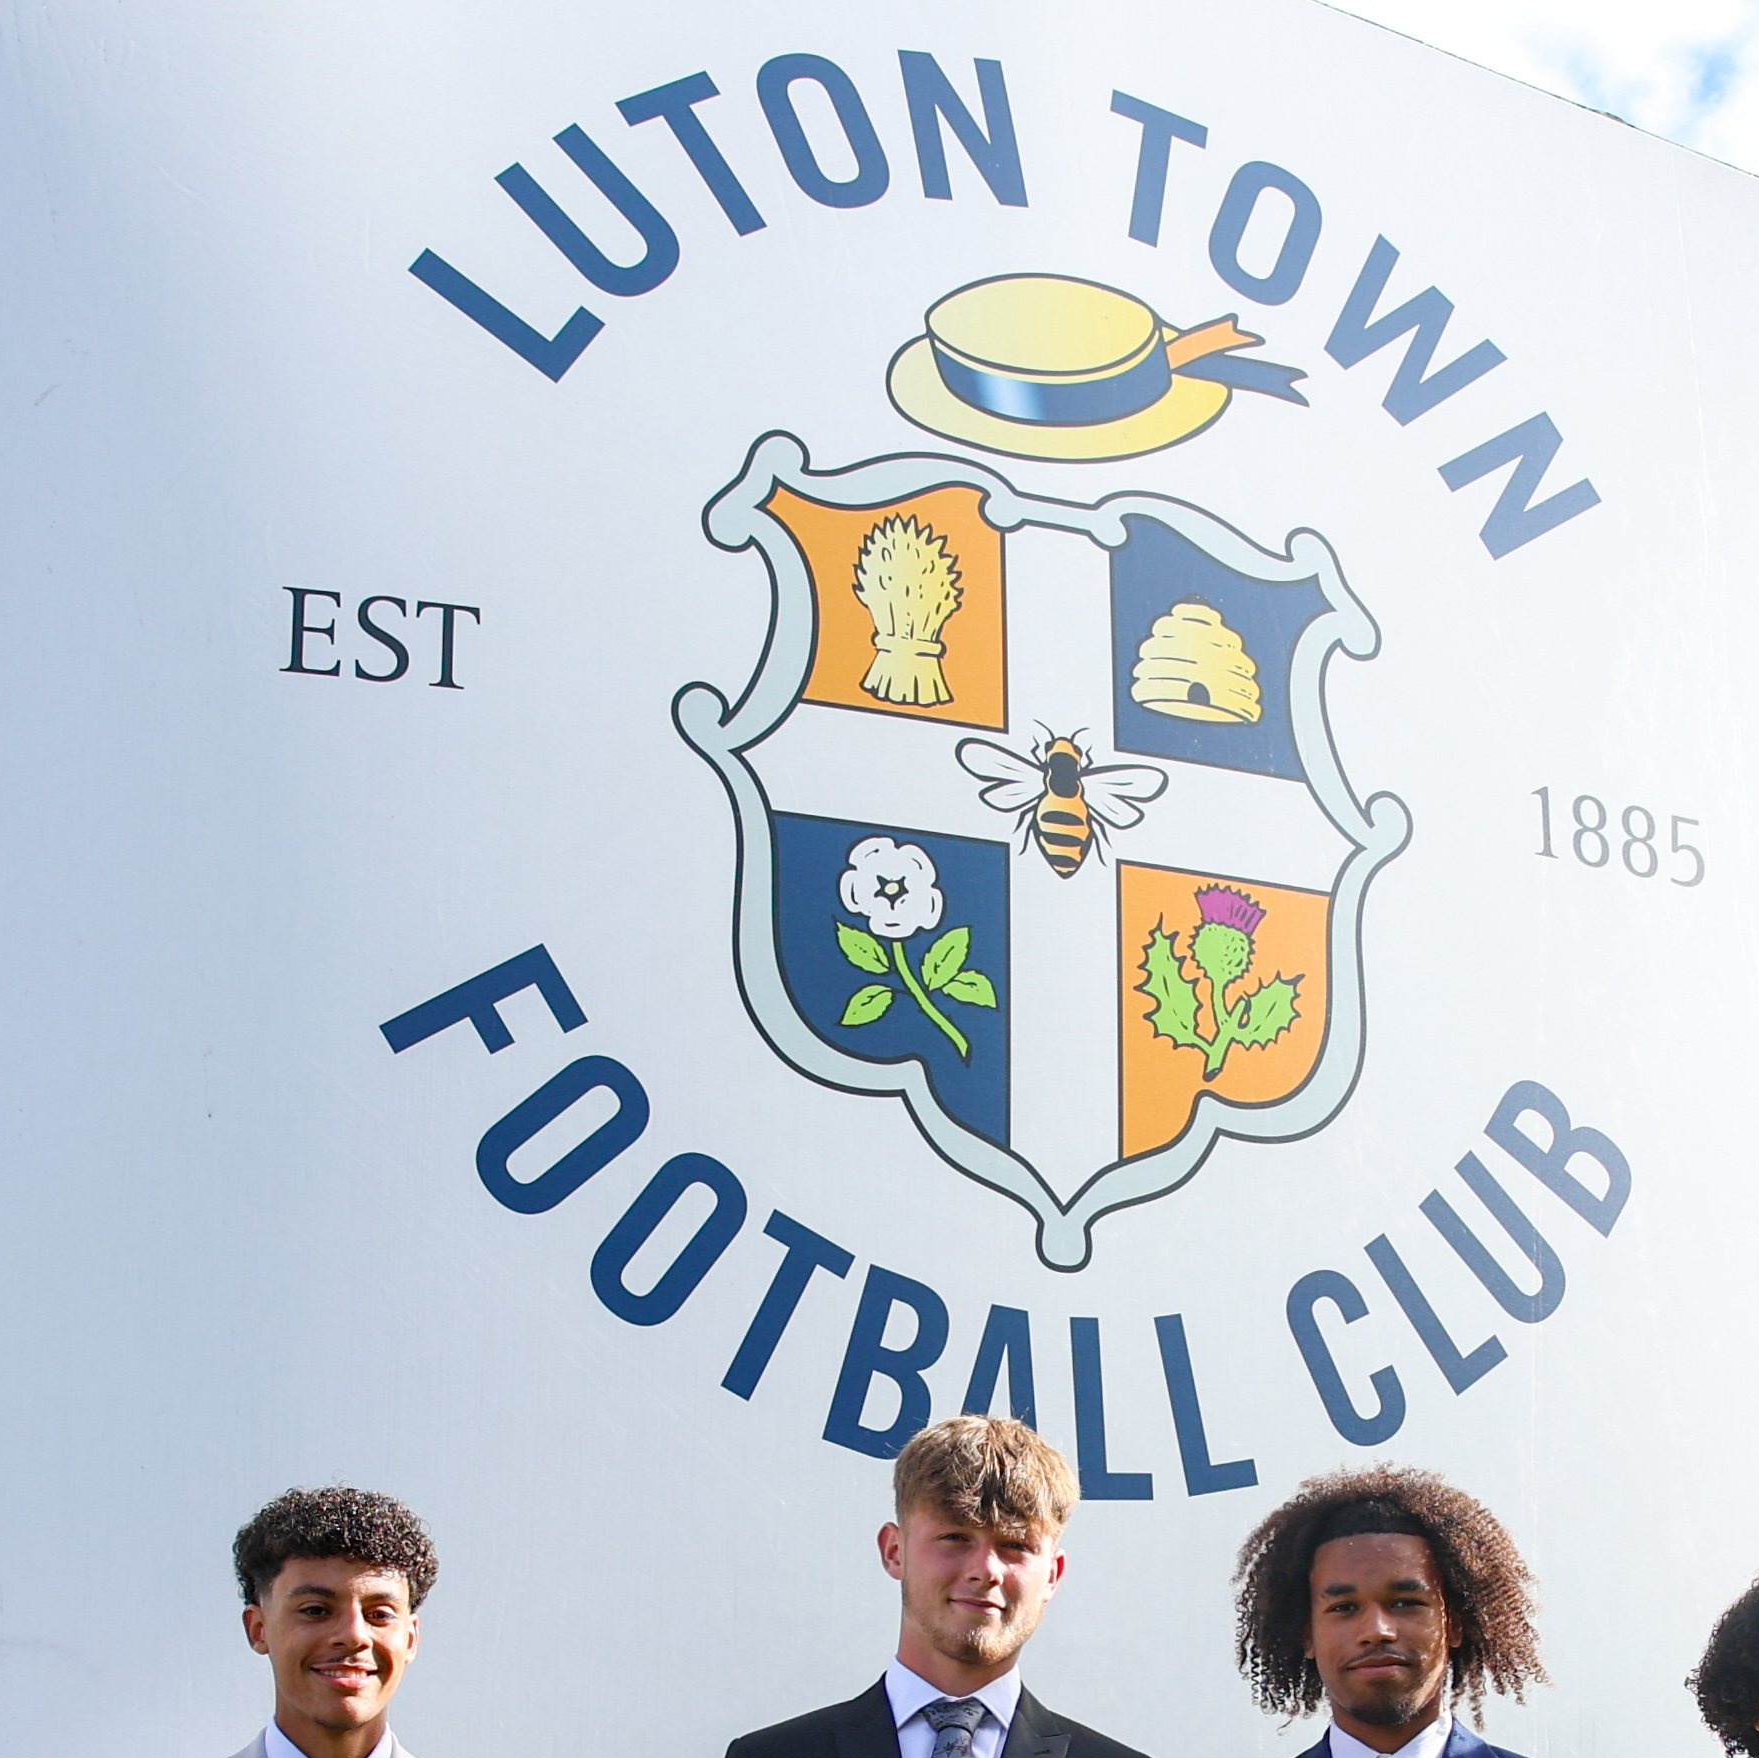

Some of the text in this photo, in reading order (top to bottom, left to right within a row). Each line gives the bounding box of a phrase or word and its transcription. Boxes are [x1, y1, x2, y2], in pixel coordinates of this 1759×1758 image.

[407, 49, 1603, 561] LUTON TOWN
[279, 586, 482, 690] EST
[1531, 786, 1706, 888] 1885
[378, 943, 1633, 1500] FOOTBALL CLUB
